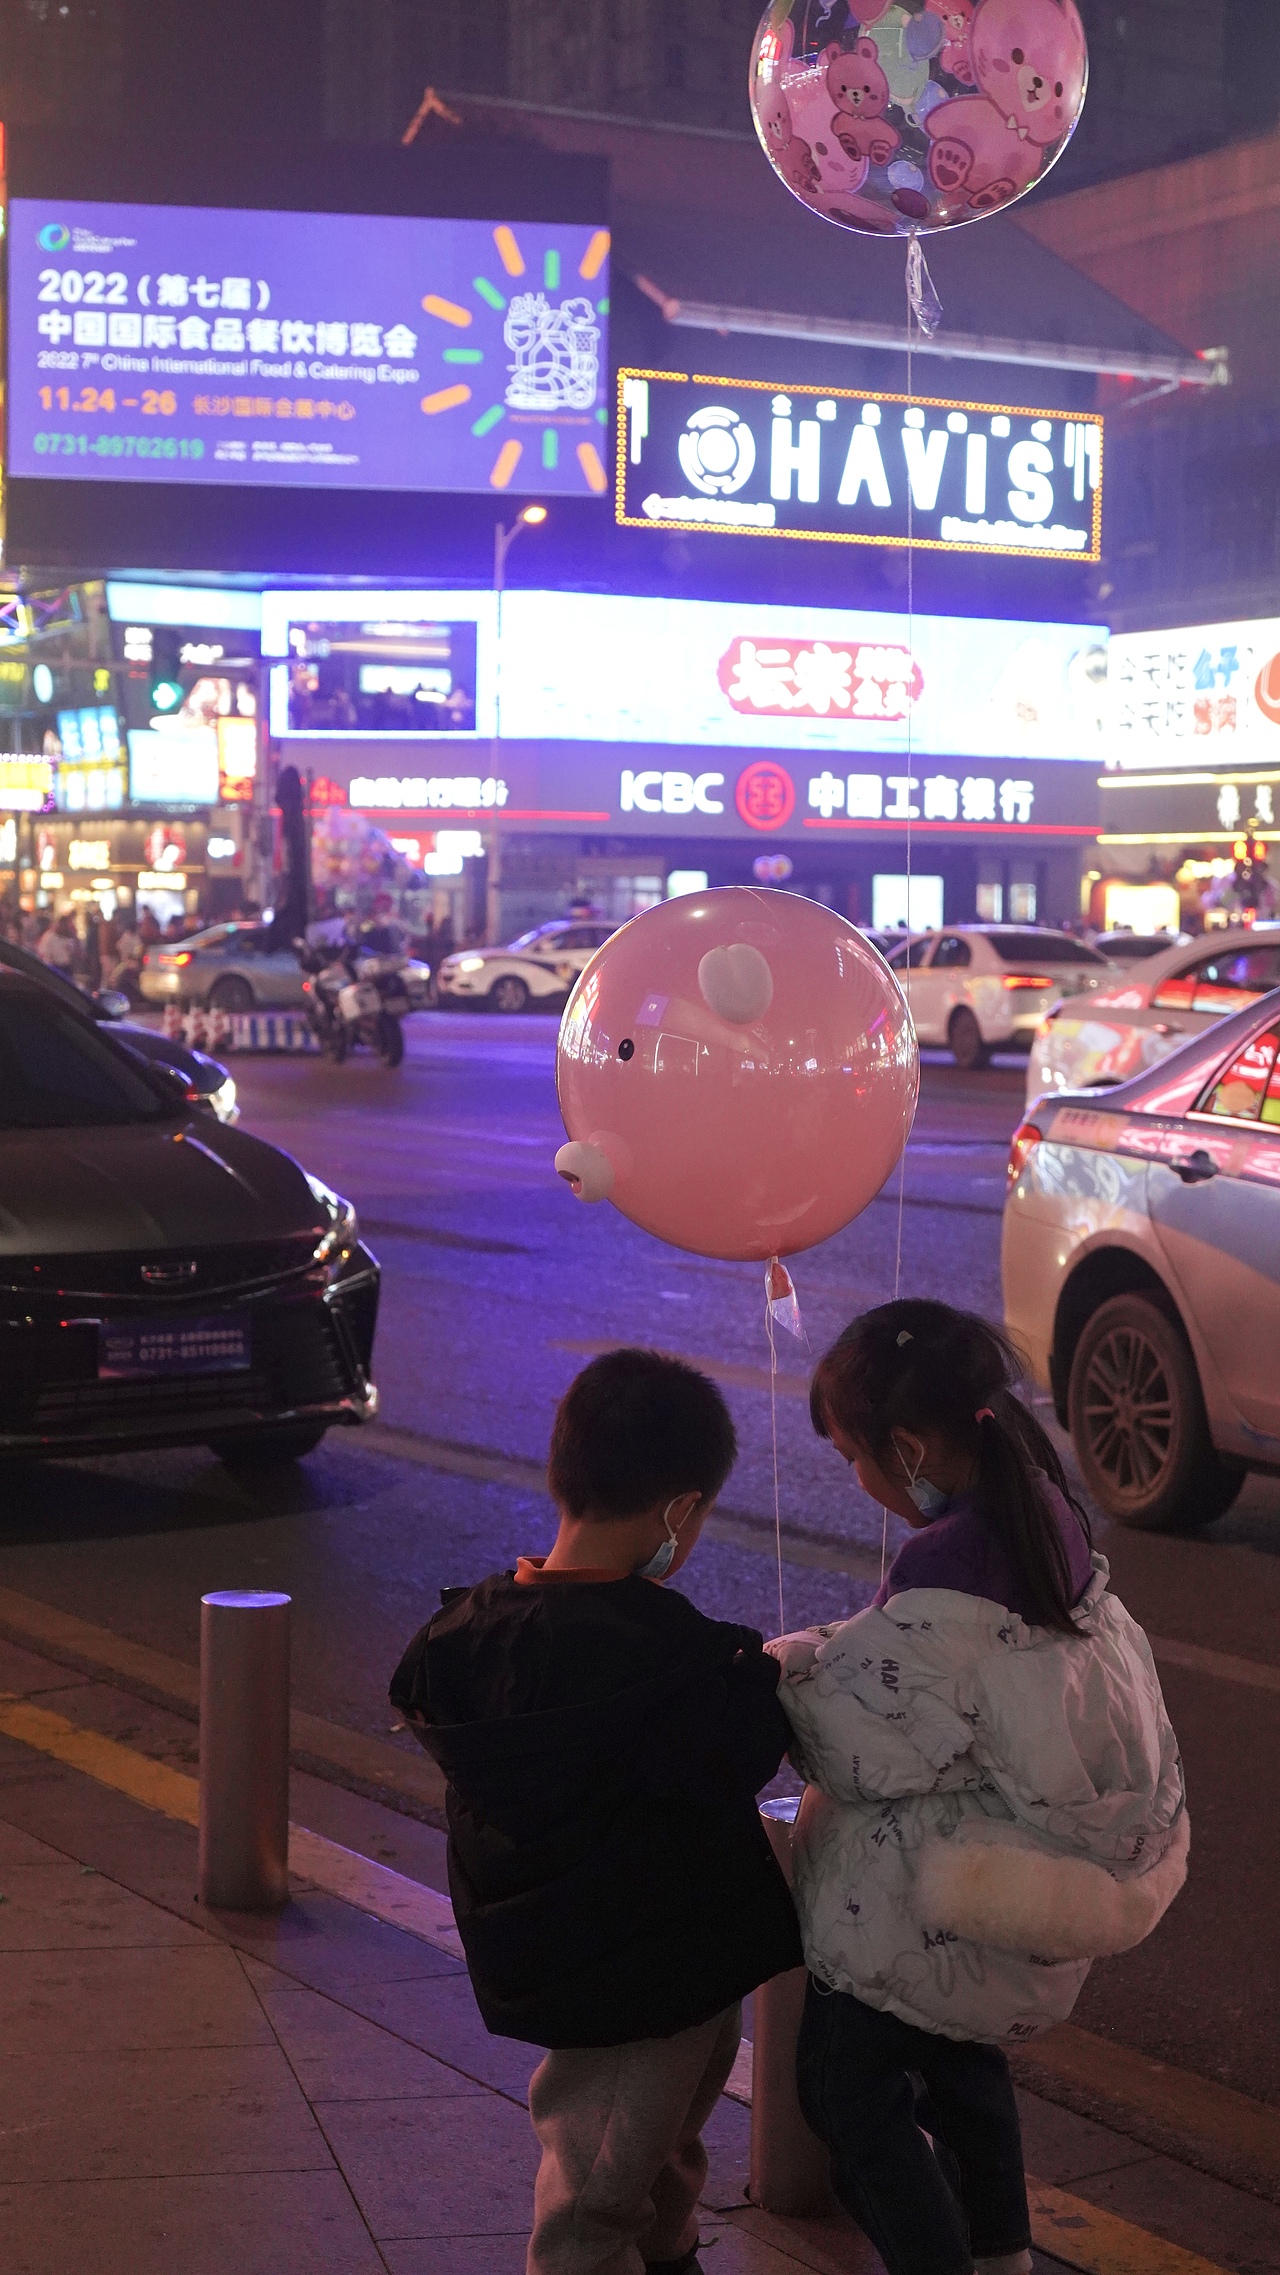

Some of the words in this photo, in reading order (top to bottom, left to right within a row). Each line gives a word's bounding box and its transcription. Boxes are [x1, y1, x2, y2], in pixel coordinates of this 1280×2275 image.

[37, 309, 418, 359] 中国国际食品餐饮博览会
[37, 351, 80, 371] 2022
[101, 353, 150, 372] China
[151, 356, 249, 376] International
[250, 359, 293, 379] Food
[293, 361, 308, 379] &
[308, 361, 377, 385] Catering
[376, 363, 420, 385] Expo
[619, 769, 725, 815] ICBC
[807, 771, 1035, 823] 中国工商银行
